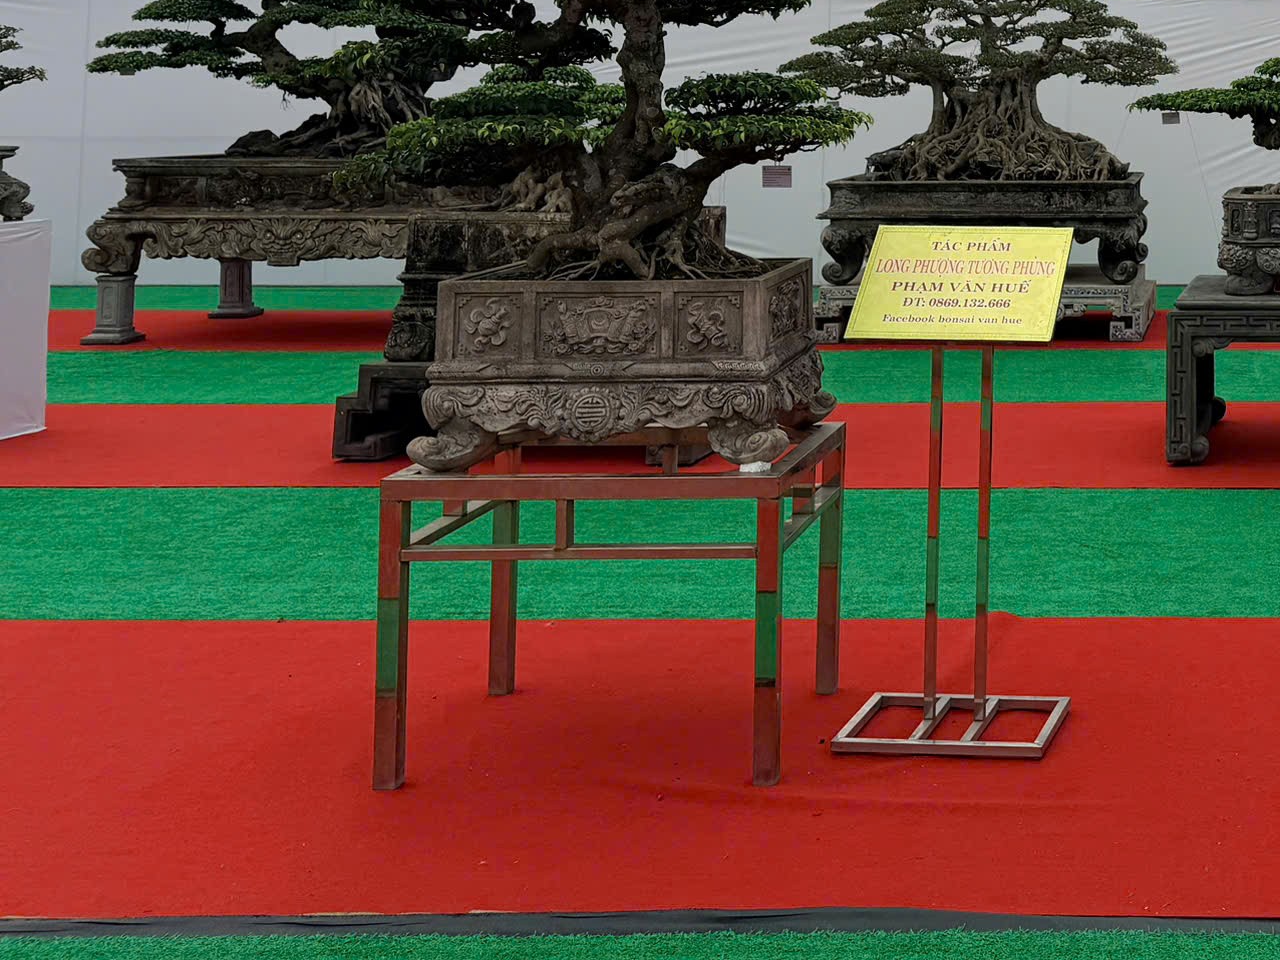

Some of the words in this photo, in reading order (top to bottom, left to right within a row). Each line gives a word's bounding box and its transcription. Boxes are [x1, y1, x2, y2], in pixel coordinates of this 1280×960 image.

[932, 239, 962, 251] TÁC
[876, 258, 911, 274] LONG
[891, 281, 944, 294] PHẠM
[950, 280, 986, 293] VĂN
[991, 279, 1032, 294] HUẾ
[902, 297, 926, 307] ĐT:
[928, 298, 1012, 309] 0869.132.666
[882, 313, 935, 323] Facebook
[938, 315, 975, 324] bonsai
